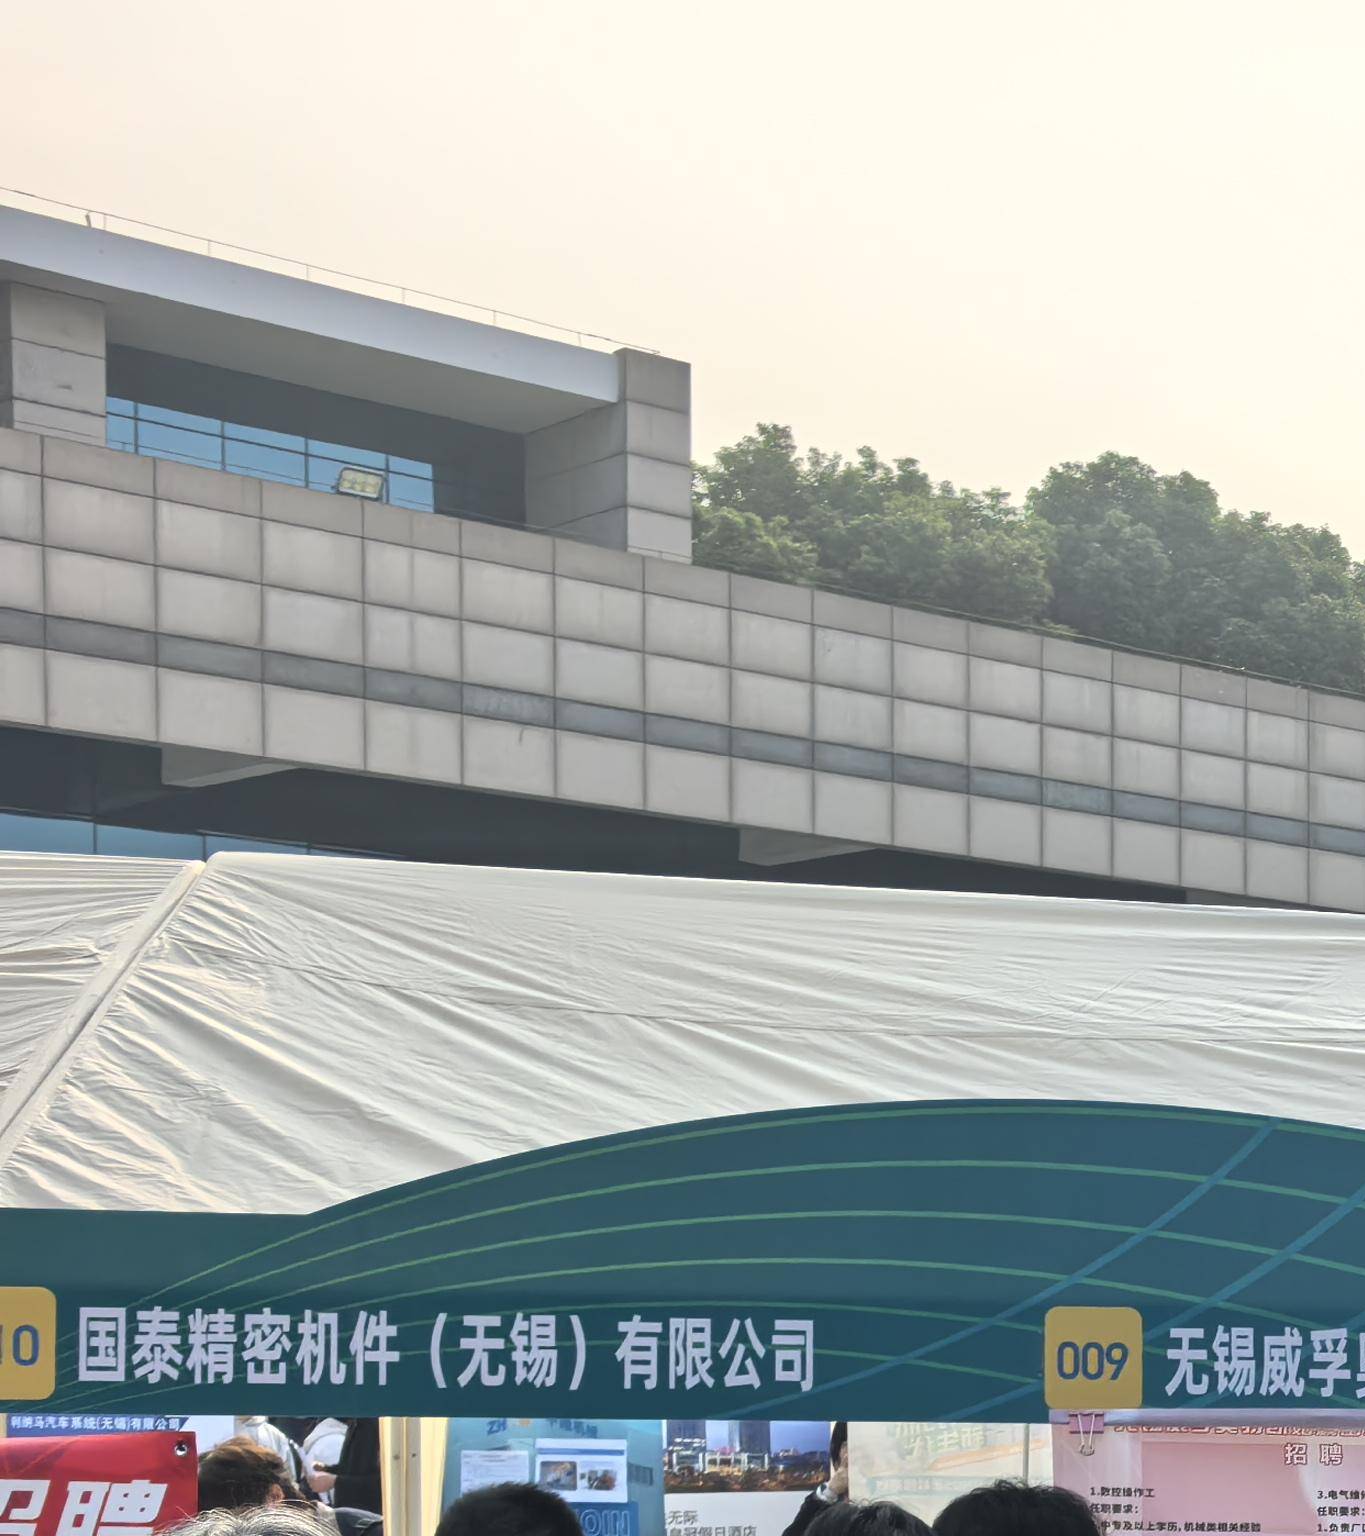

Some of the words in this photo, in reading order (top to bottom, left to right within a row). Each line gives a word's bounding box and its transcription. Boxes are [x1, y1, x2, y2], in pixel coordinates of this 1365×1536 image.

[0, 1323, 40, 1367] 0
[77, 1306, 816, 1392] 国泰精密机件（无锡）有限公司
[1056, 1339, 1129, 1382] 009
